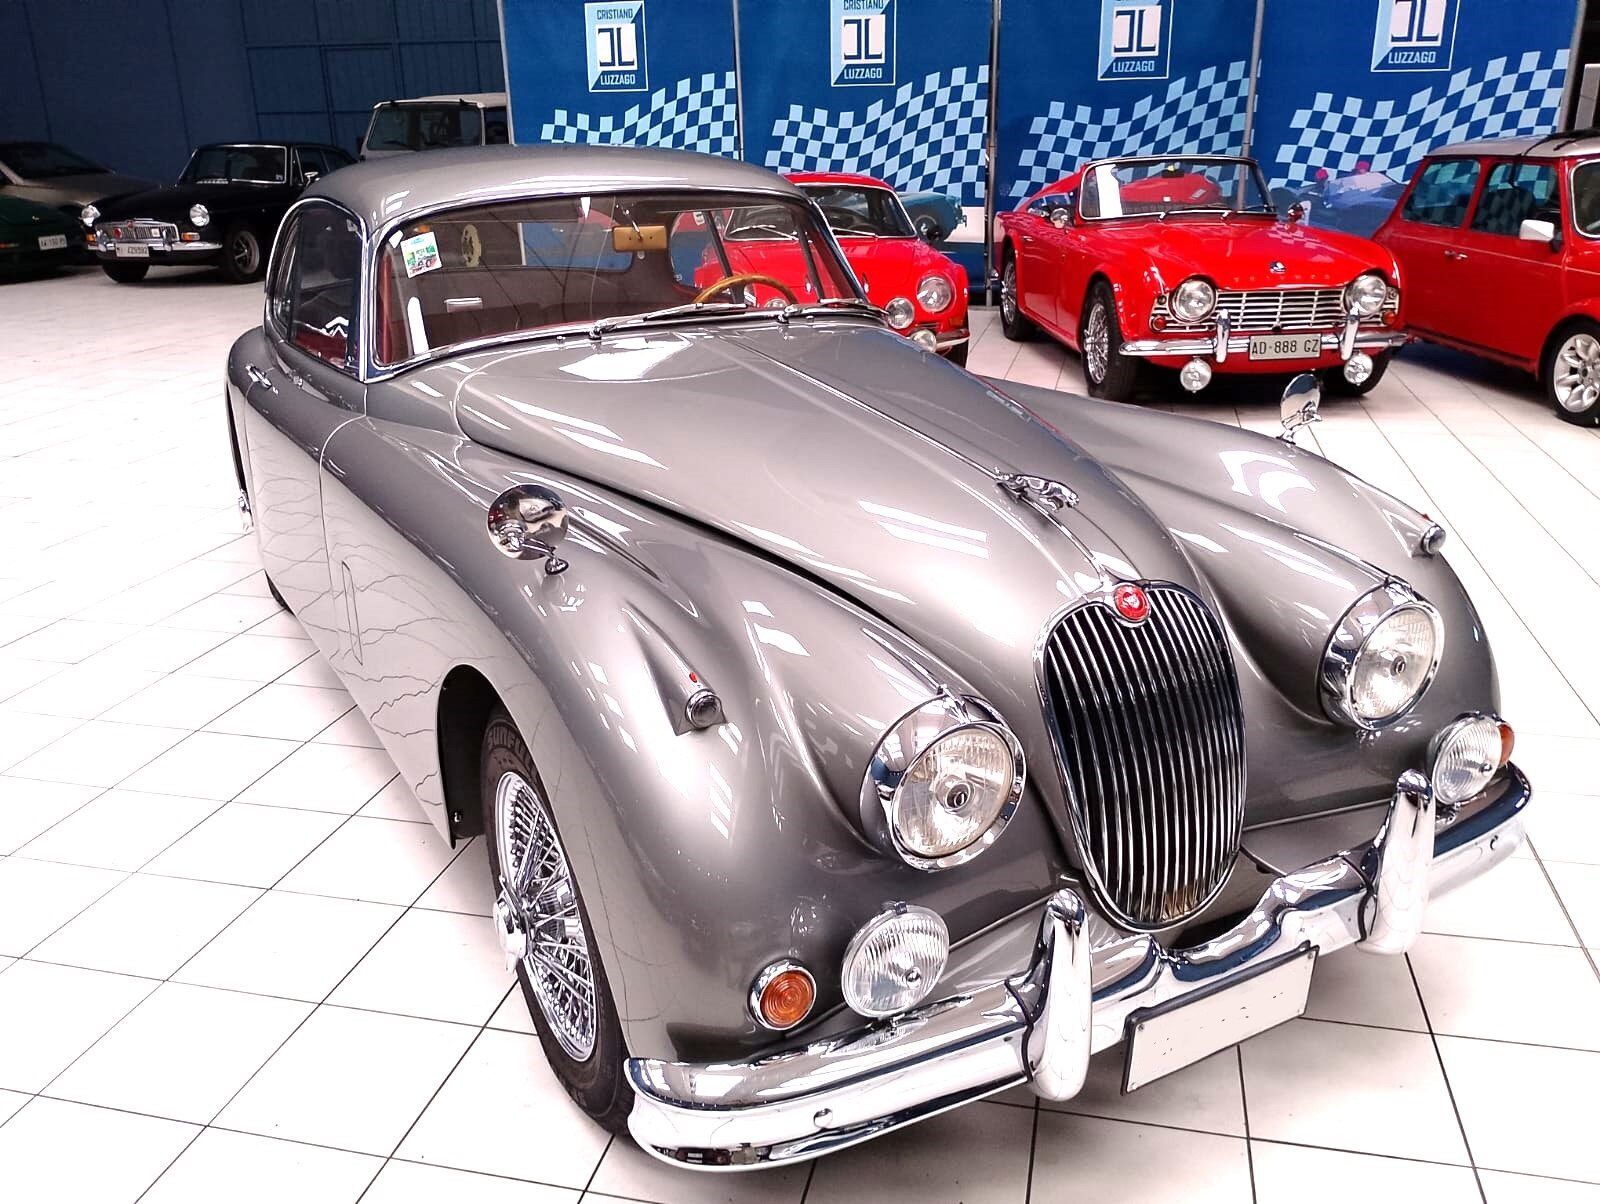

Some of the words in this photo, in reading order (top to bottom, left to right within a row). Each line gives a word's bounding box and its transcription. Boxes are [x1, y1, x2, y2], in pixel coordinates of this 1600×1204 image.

[843, 0, 884, 10] CRISTIANO
[597, 8, 634, 20] CRISTIANO
[1388, 51, 1437, 64] LUZZAGO
[1112, 60, 1155, 73] LUZZAGO
[843, 68, 883, 79] LUZZAGO
[600, 74, 636, 86] LUZZAGO
[1304, 339, 1319, 353] GZ
